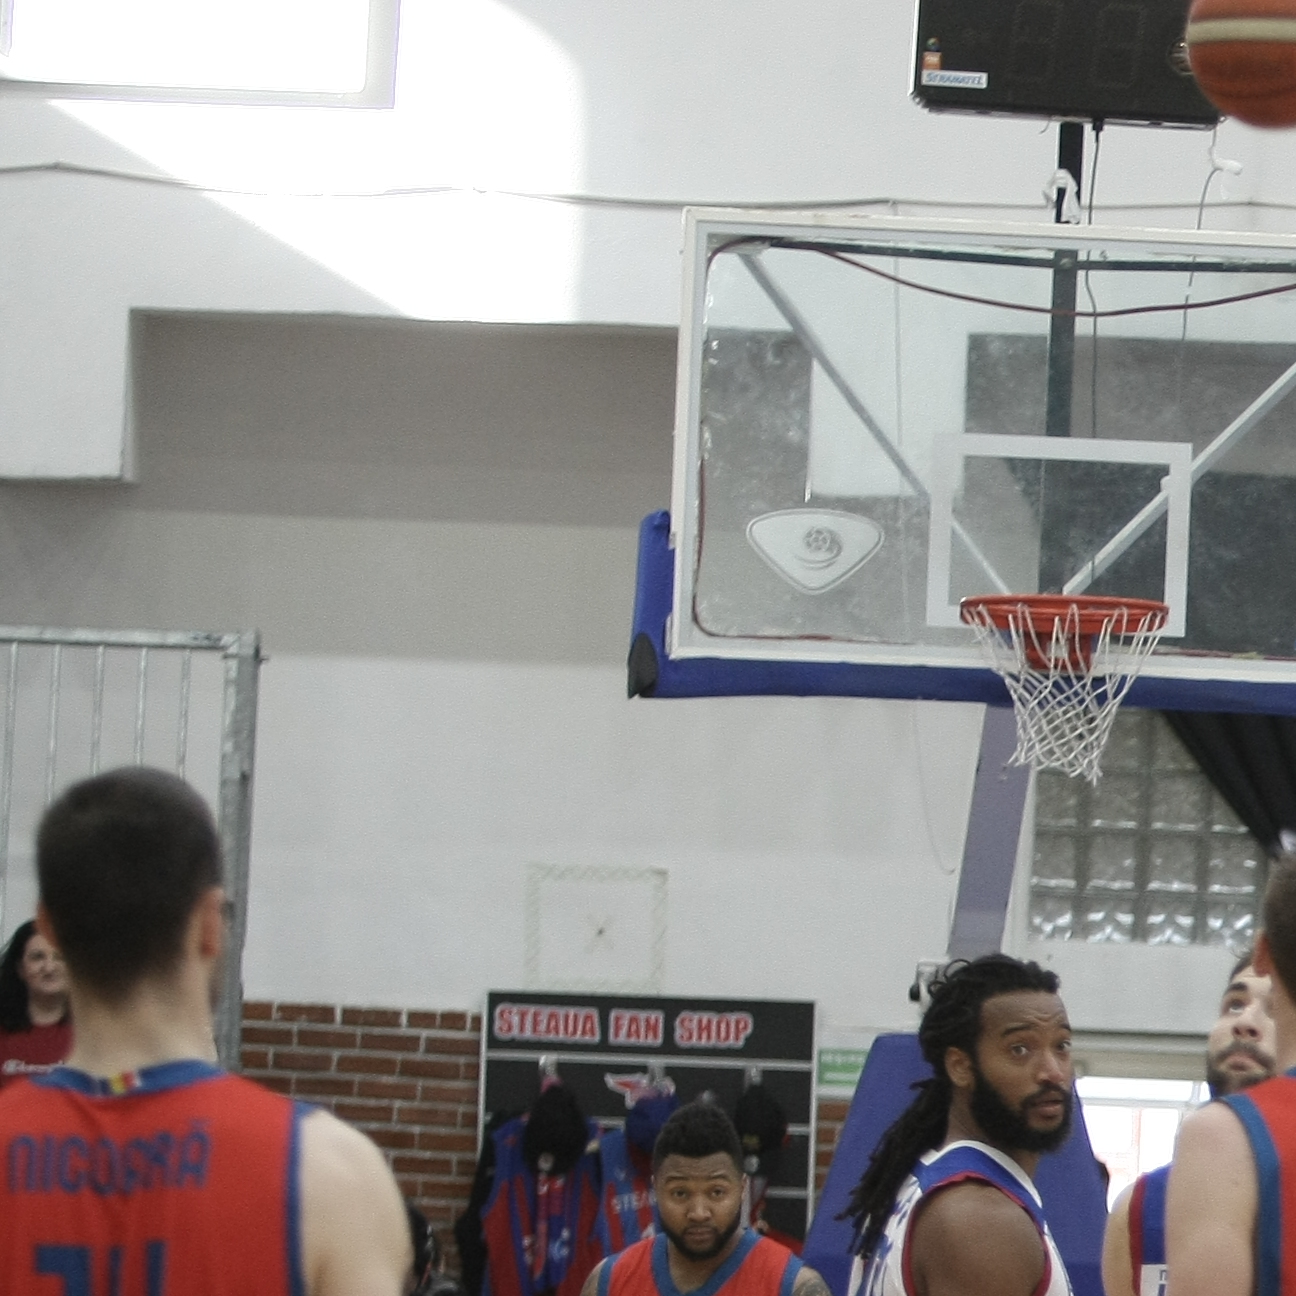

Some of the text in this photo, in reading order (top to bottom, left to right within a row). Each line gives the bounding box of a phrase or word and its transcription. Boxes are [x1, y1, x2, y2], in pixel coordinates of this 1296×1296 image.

[495, 1003, 753, 1048] STEAUA FAN SHOP
